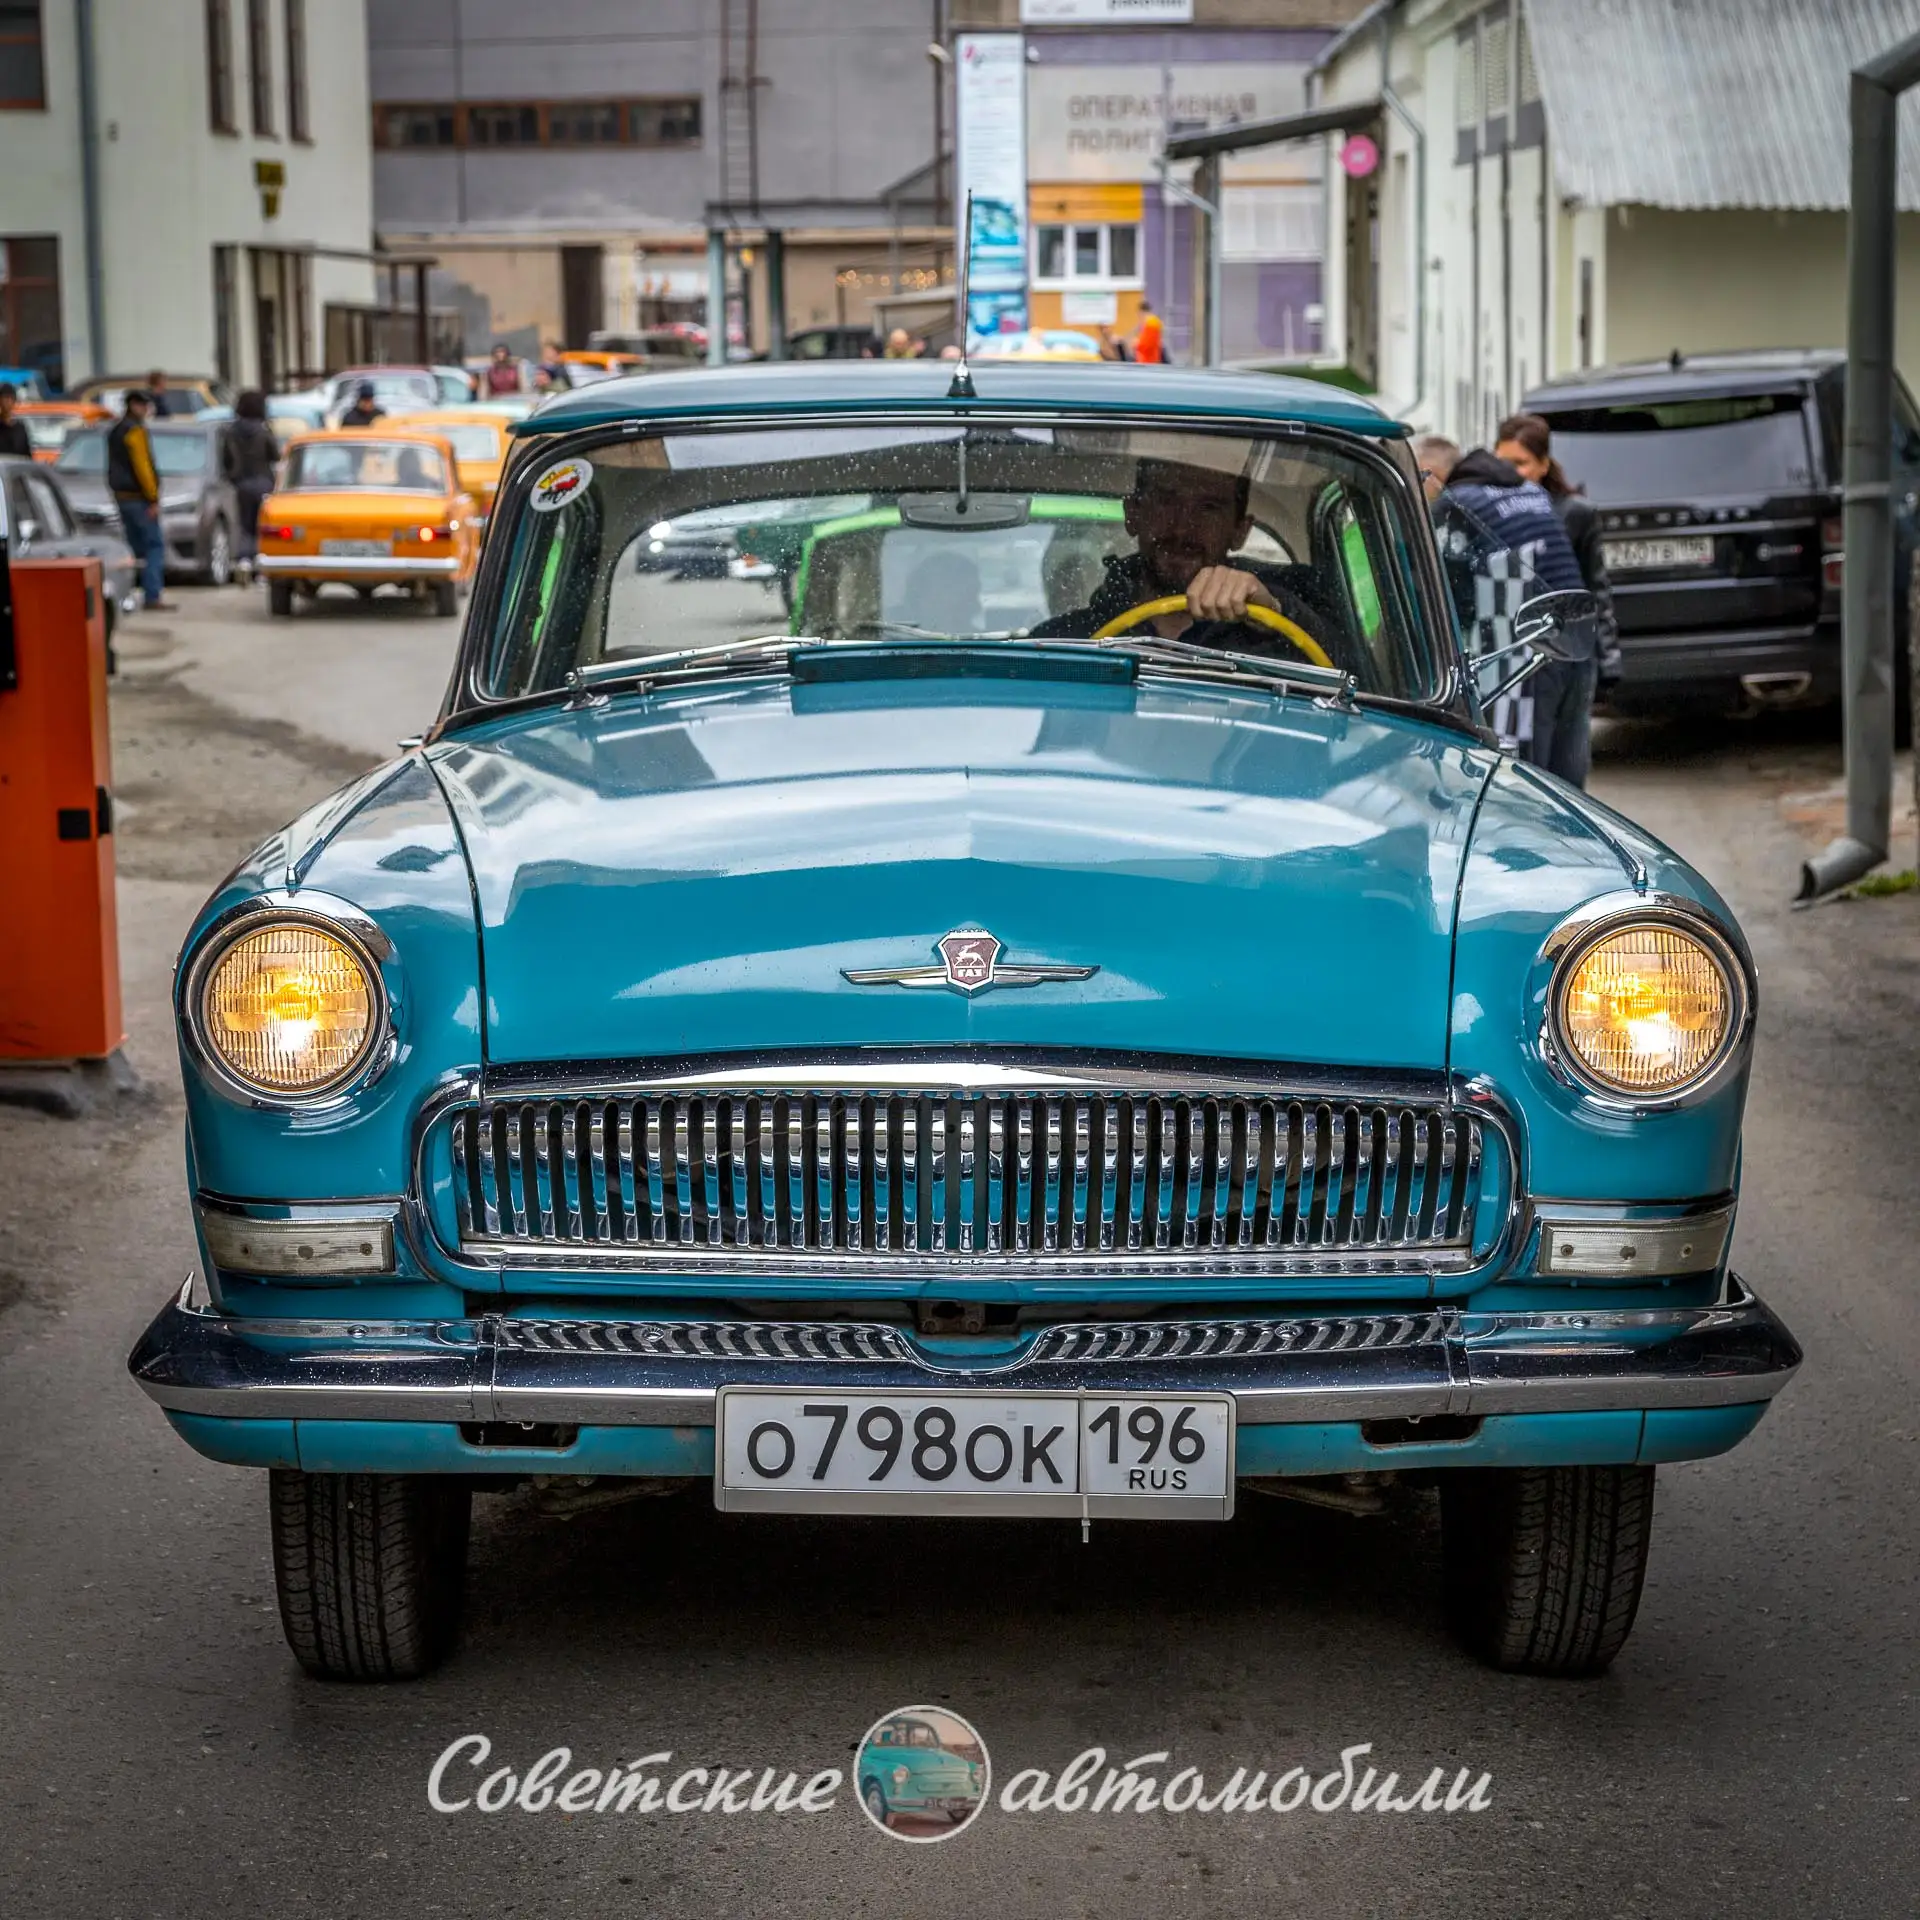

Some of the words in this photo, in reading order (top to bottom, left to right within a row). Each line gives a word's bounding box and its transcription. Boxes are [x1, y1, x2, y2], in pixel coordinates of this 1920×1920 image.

[747, 1404, 1064, 1483] О798ОК
[1089, 1406, 1205, 1464] 196
[1129, 1468, 1187, 1490] RUS
